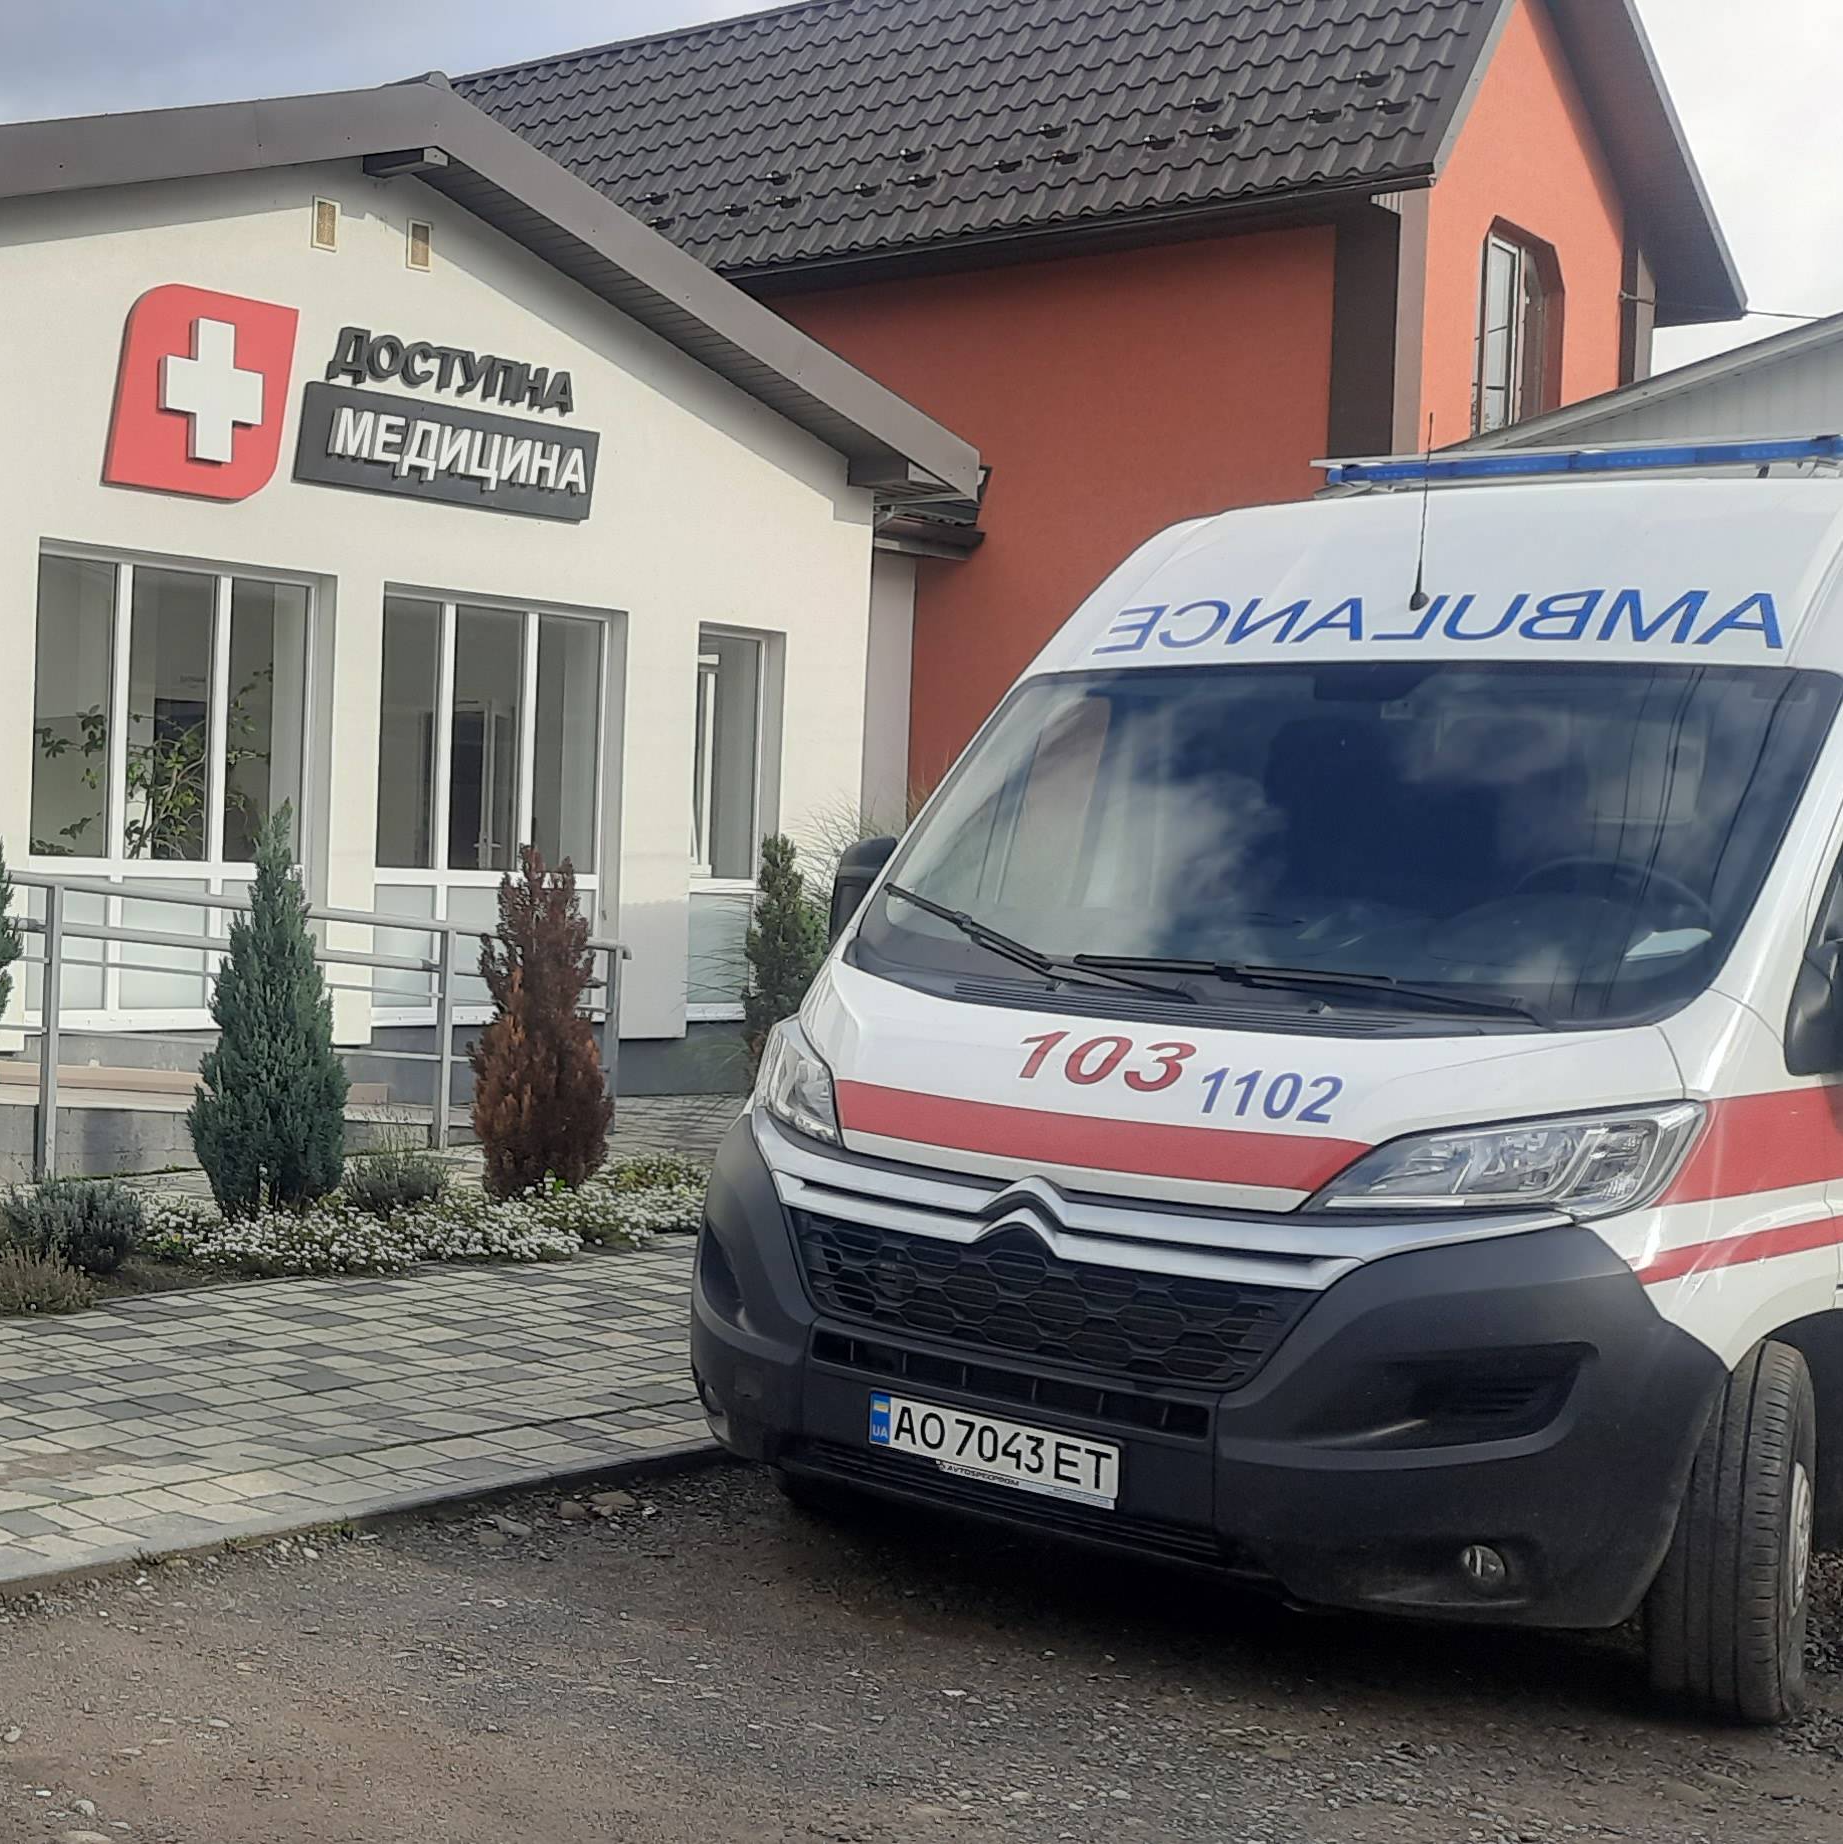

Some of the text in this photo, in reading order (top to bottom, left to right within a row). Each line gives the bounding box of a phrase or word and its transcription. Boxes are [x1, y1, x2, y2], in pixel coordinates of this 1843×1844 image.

[325, 326, 574, 415] ДОСТУПНА
[330, 406, 587, 496] МЕДИЦИНА
[1018, 1031, 1344, 1124] 103 1102
[872, 1423, 889, 1439] UA
[894, 1406, 1113, 1490] AO 7043 ET
